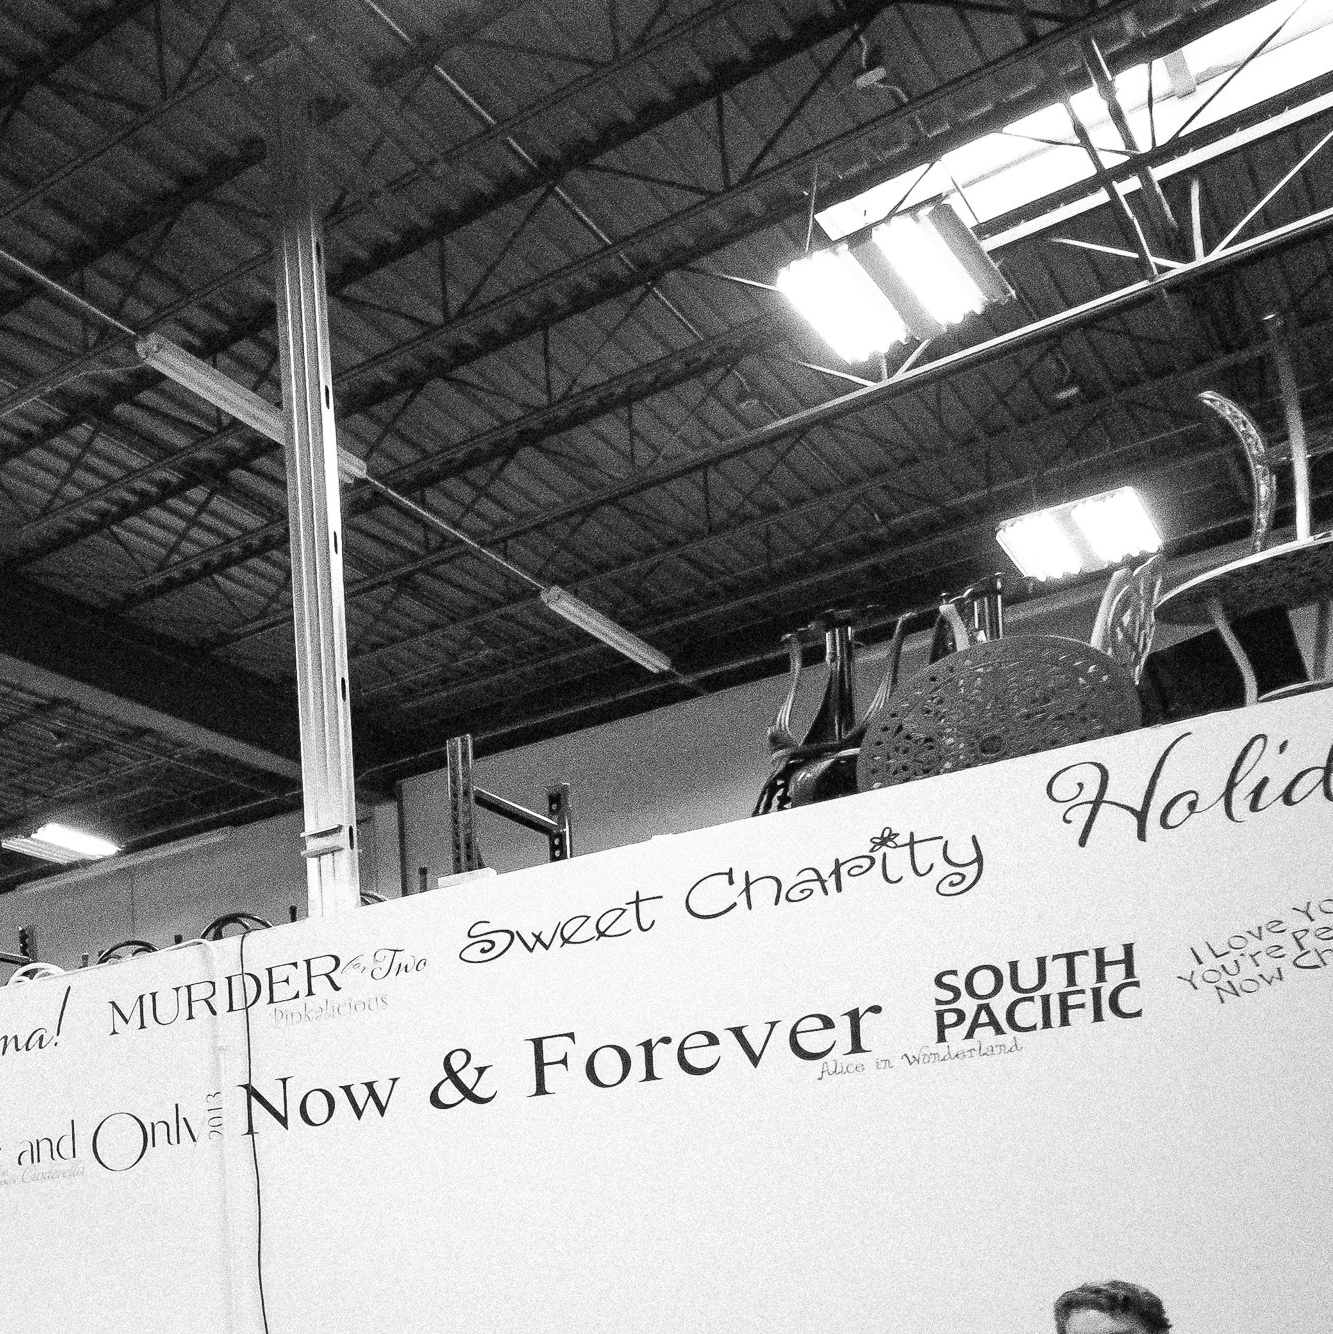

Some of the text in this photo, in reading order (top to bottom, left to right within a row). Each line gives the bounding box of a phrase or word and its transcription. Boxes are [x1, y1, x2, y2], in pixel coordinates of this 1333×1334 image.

[459, 826, 986, 964] Sweet Charity
[108, 954, 342, 1036] MURDER
[371, 948, 428, 980] Two
[934, 942, 1137, 1006] SOUTH
[934, 980, 1144, 1045] PACIFIC
[237, 1004, 882, 1137] Now & Forever
[817, 1036, 1023, 1081] Alice in Wonderland
[18, 1119, 76, 1166] and
[92, 1103, 206, 1171] Only
